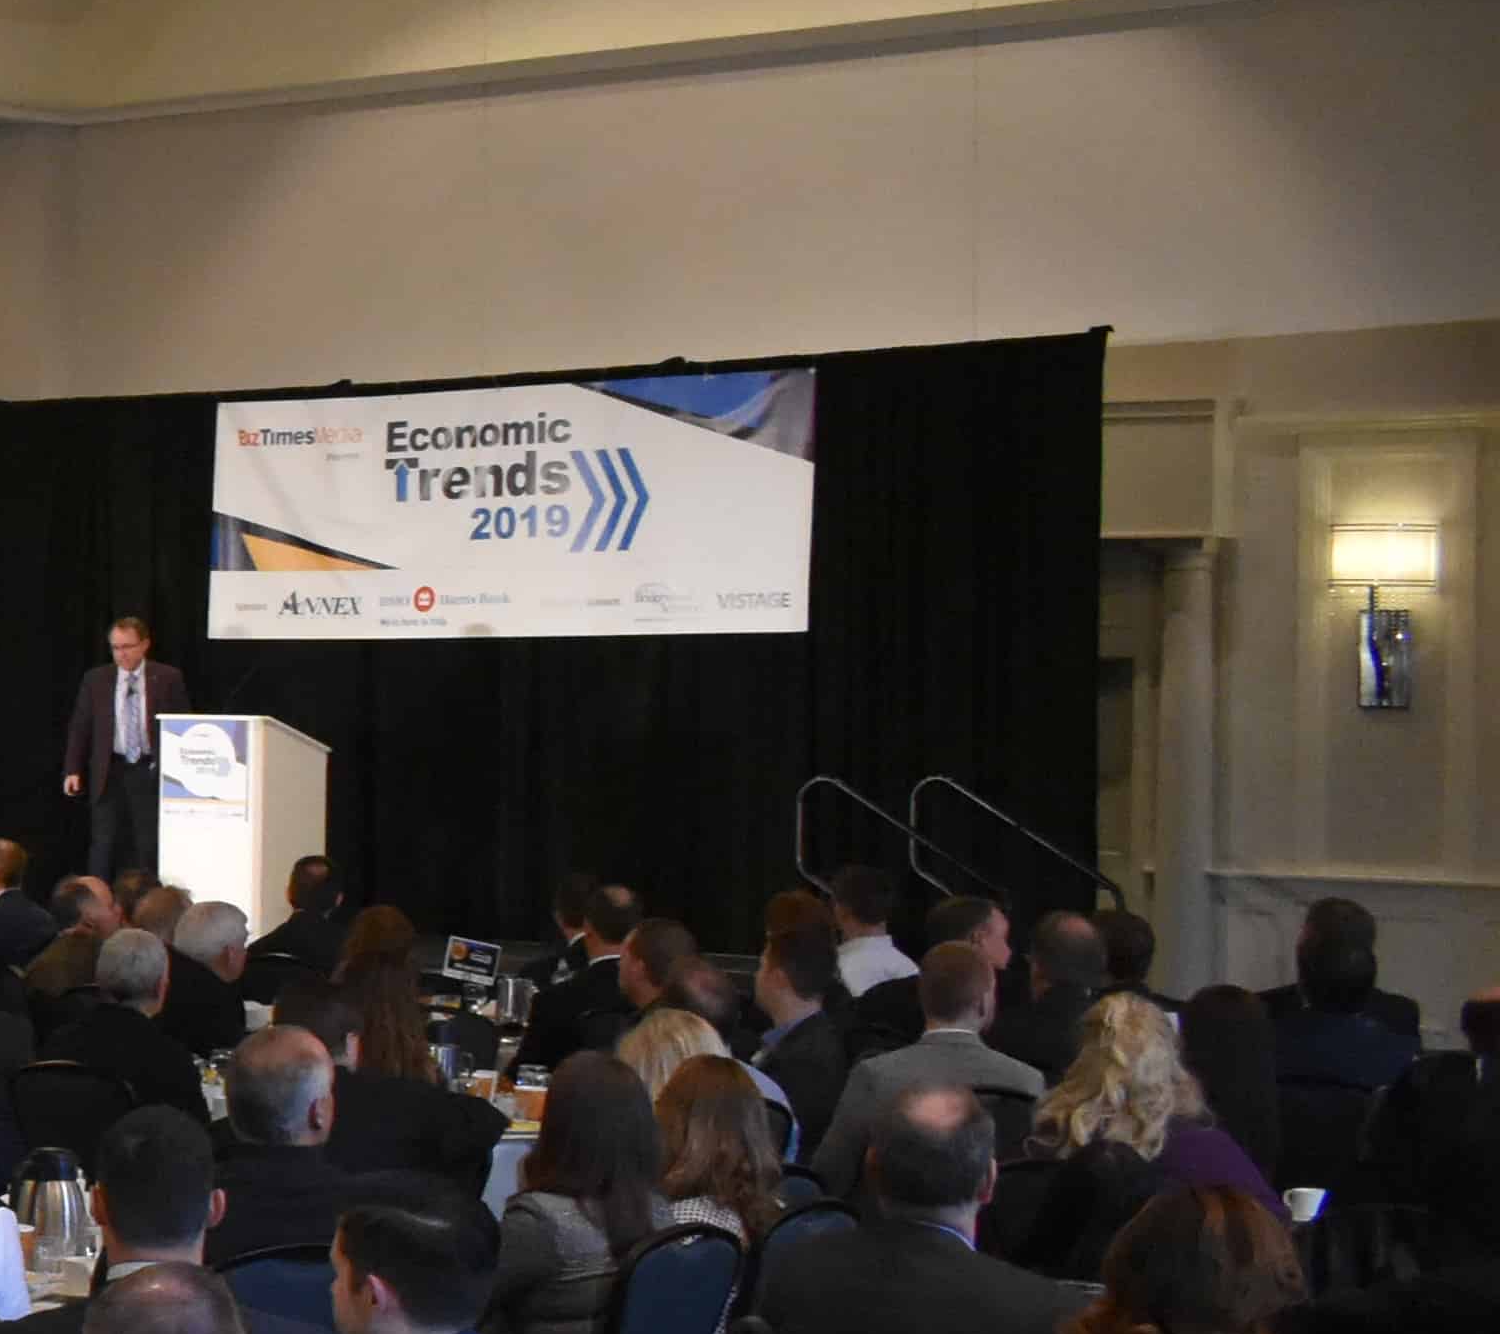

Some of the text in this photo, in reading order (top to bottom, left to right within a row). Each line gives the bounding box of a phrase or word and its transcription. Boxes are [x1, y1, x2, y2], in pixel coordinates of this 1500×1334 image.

[385, 412, 572, 453] Economic
[385, 450, 572, 503] Trends
[469, 504, 571, 541] 2019
[277, 590, 364, 616] ANNEX
[715, 591, 792, 610] VISTAGE
